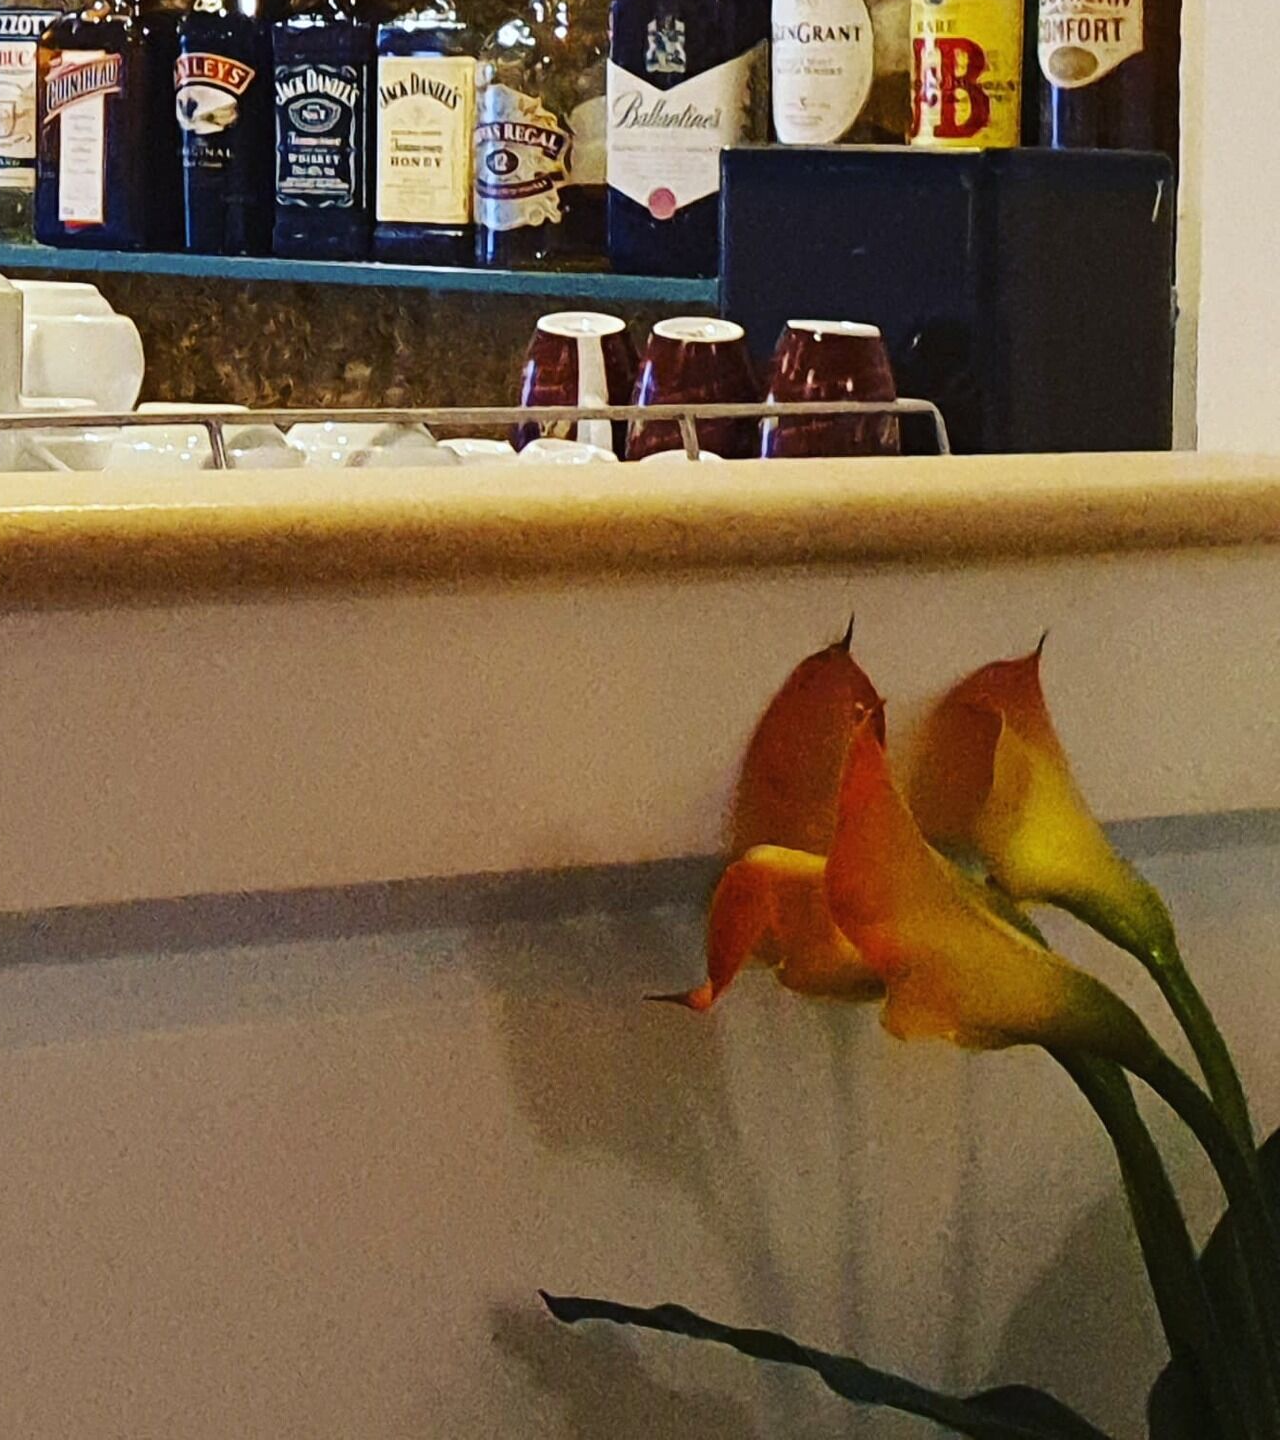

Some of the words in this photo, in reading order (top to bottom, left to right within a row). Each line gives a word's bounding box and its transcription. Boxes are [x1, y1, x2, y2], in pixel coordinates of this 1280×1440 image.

[613, 90, 722, 129] Ballantine's
[503, 122, 558, 150] REGAL
[390, 156, 442, 168] HONEY
